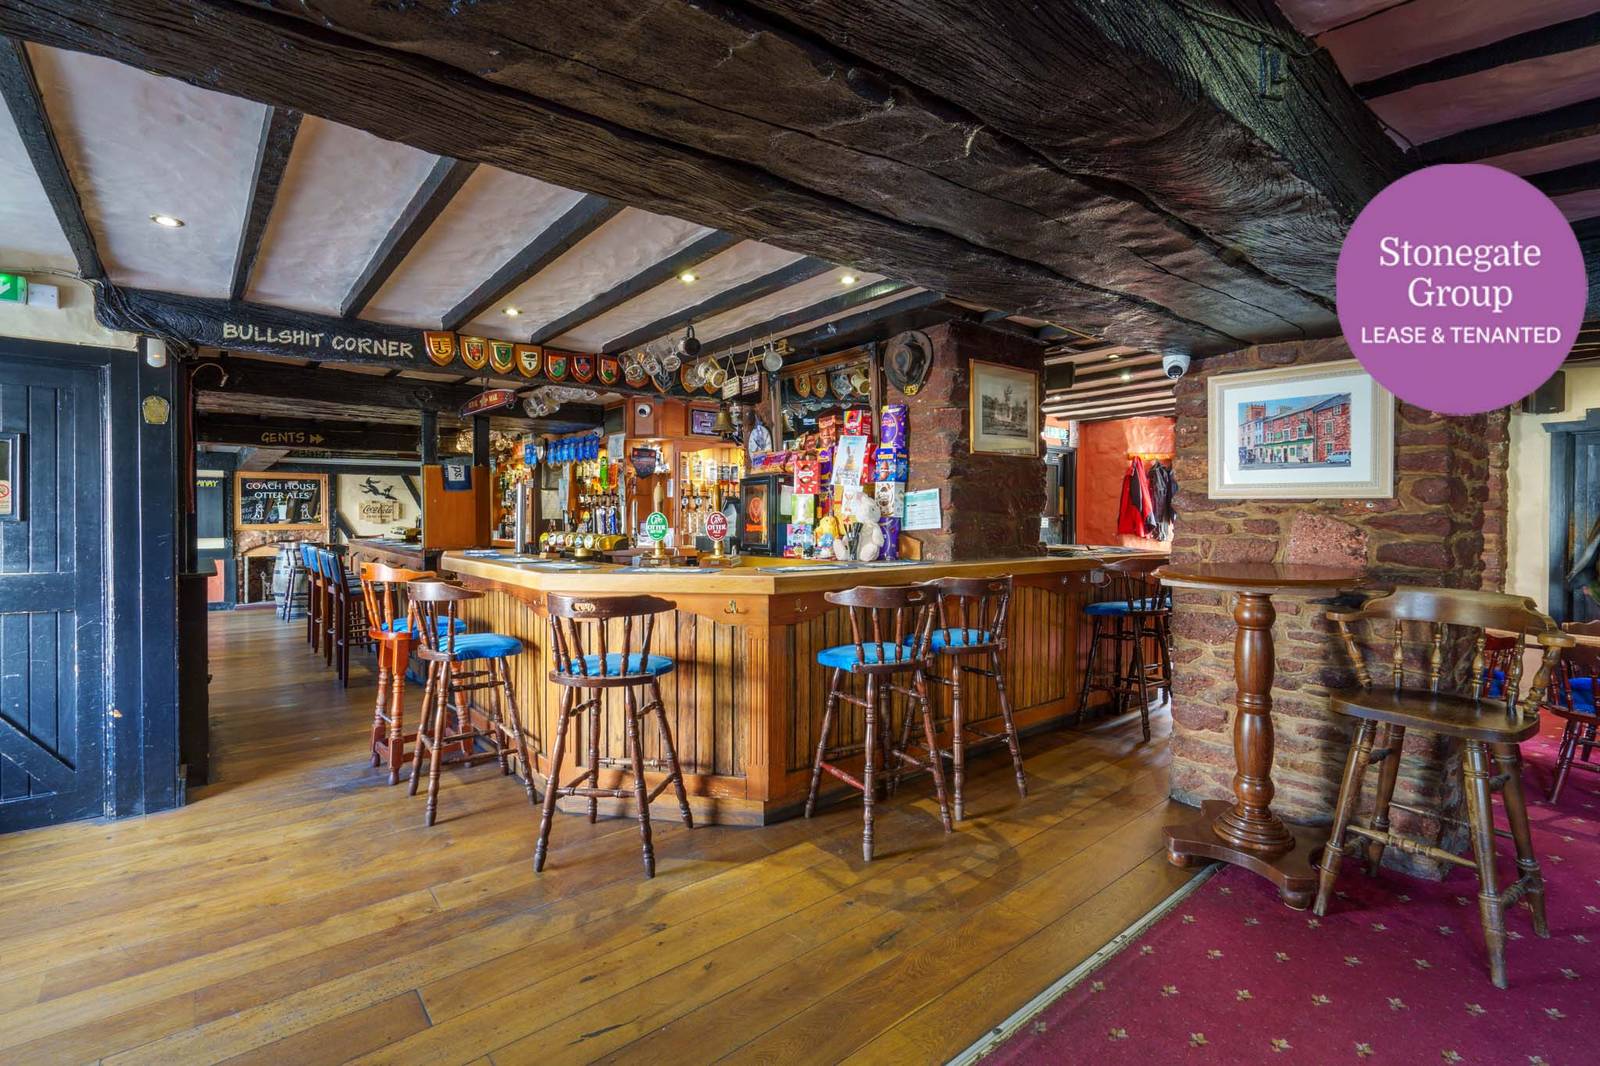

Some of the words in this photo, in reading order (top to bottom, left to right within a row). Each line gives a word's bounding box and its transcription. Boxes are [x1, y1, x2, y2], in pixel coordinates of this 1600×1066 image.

[223, 322, 325, 347] BULLSHIT
[331, 335, 414, 358] CORNER
[260, 432, 305, 444] GENTS
[245, 482, 282, 490] COACH
[254, 491, 285, 499] OTTER
